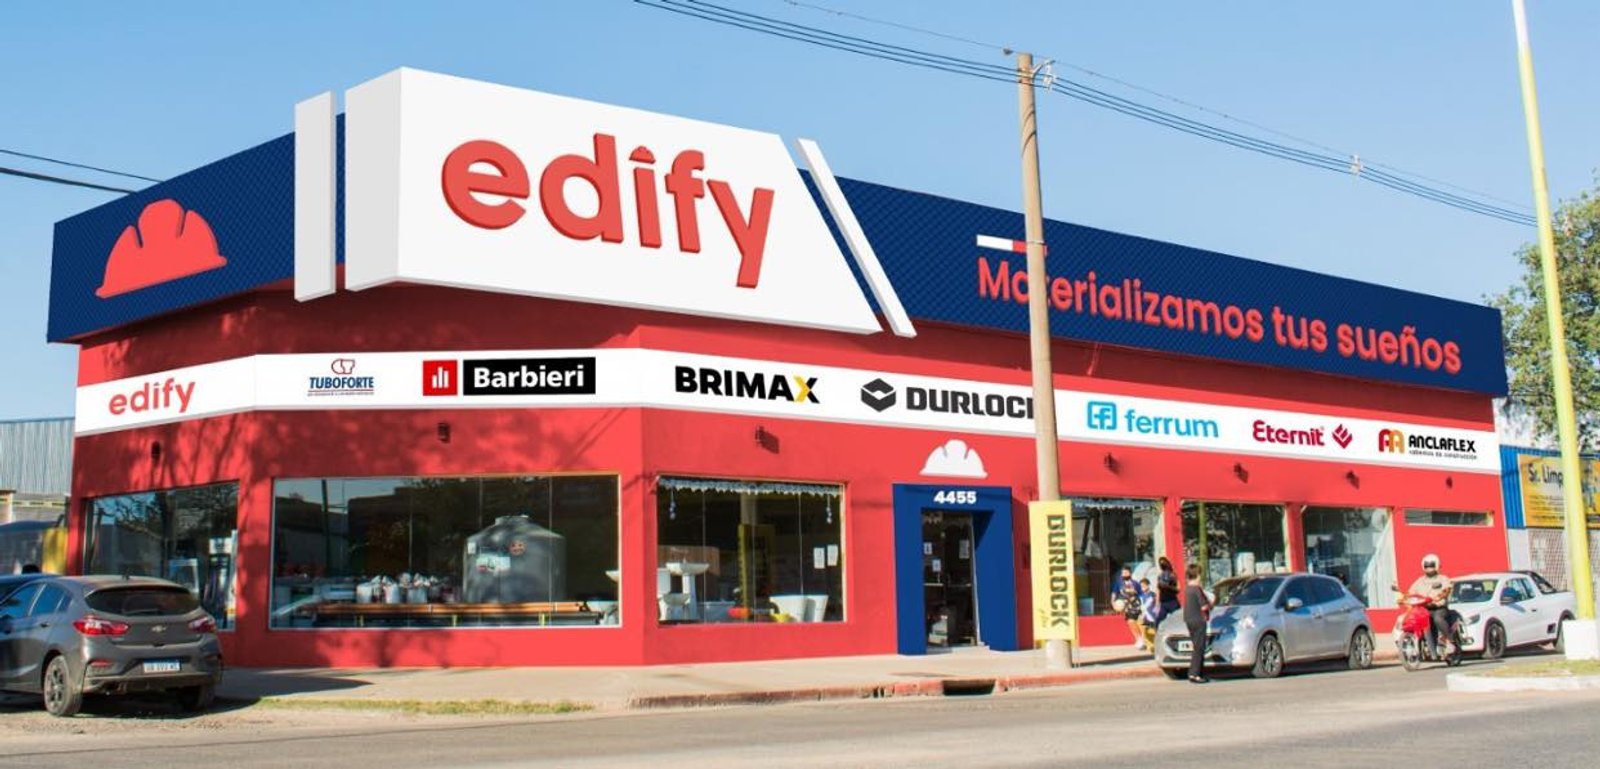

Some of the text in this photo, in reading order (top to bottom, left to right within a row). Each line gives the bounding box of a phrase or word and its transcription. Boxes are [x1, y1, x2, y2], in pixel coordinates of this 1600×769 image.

[441, 132, 775, 289] edify
[977, 256, 1463, 374] Maerializamos tus sueños
[309, 376, 375, 389] TUBOFORTE
[473, 364, 585, 389] Barbieri
[675, 365, 821, 405] BRIMAX
[108, 377, 196, 415] edify
[1124, 408, 1219, 438] ferrum
[1252, 419, 1325, 447] Eternit
[1408, 434, 1477, 453] ANCLAFLEX
[1542, 463, 1563, 488] Limp
[933, 490, 977, 504] 4455
[1047, 514, 1070, 627] DURLOCK
